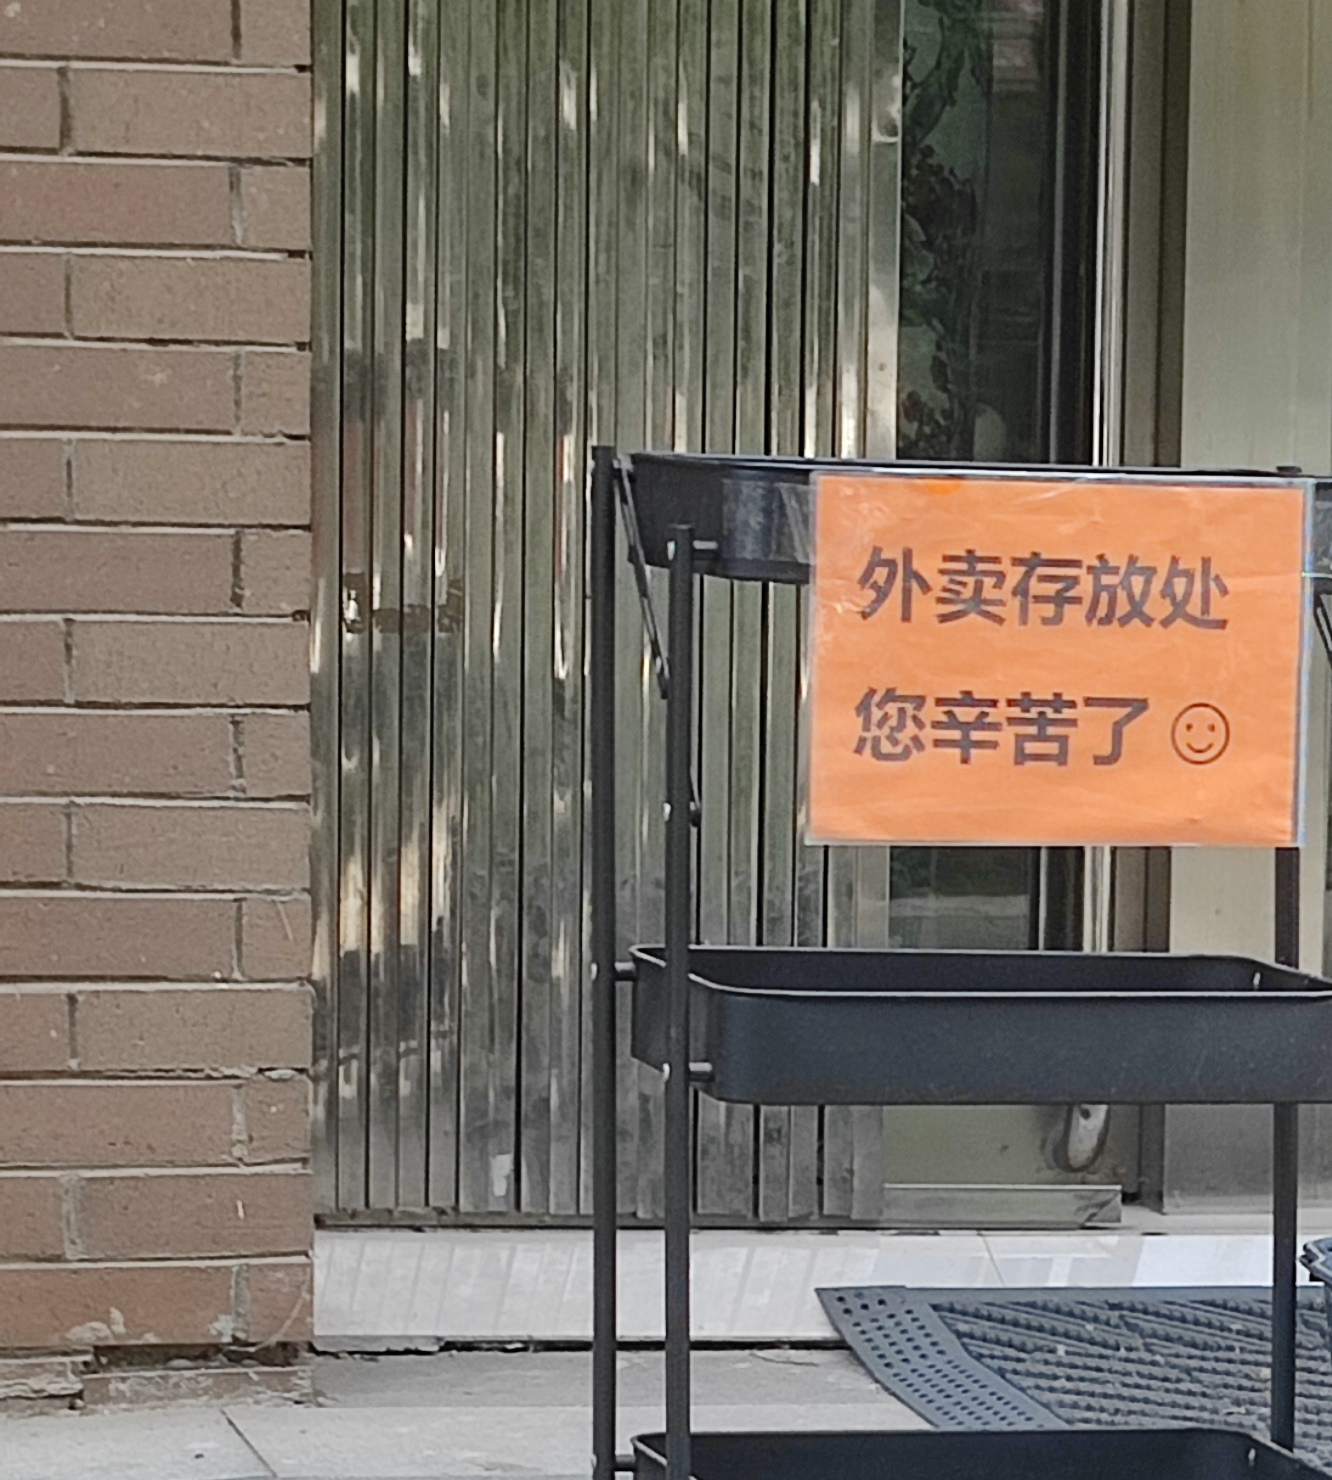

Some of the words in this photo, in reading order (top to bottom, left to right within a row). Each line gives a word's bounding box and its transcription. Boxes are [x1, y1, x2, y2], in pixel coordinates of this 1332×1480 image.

[856, 546, 1230, 630] 外卖存放处
[853, 686, 1150, 766] 您辛苦了
